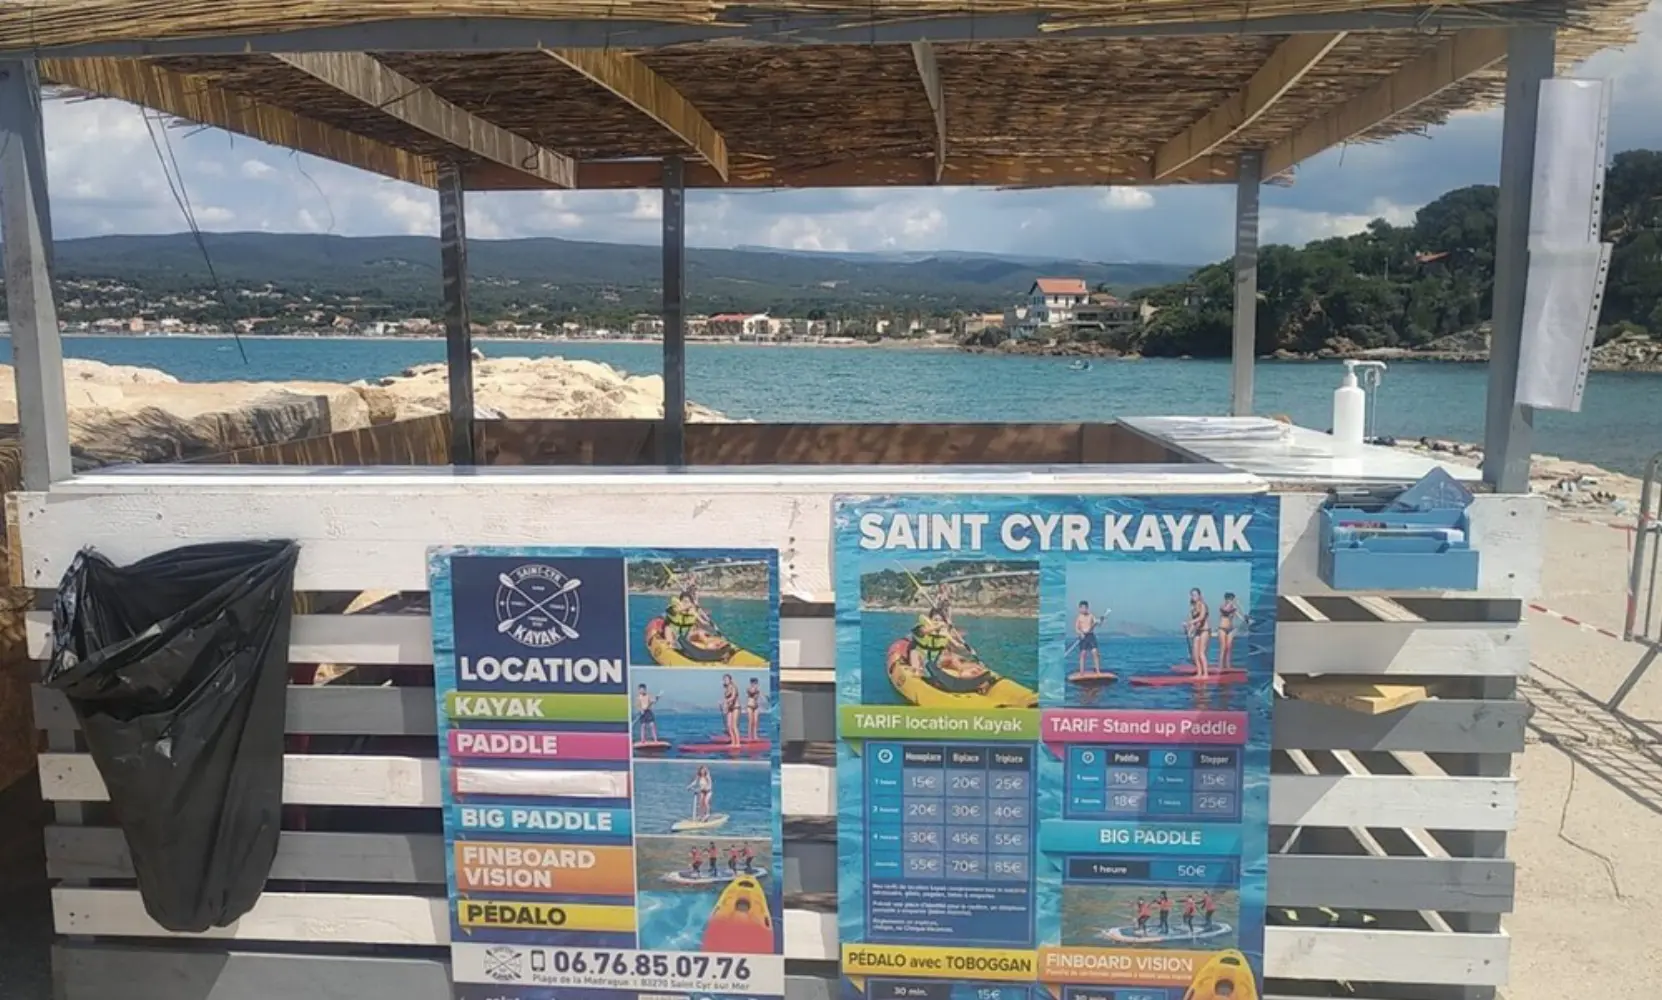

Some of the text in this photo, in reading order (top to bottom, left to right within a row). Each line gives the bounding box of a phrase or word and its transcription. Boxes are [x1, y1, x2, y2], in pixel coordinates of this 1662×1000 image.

[859, 513, 1253, 552] SAINT CYR KAYAK
[513, 624, 561, 645] KAYAK
[460, 656, 623, 684] LOCATION
[454, 695, 545, 717] KAYAK
[855, 714, 1022, 734] TARIF location Kayak
[1050, 717, 1237, 737] TARIF Stand up Paddle
[456, 733, 557, 755] PADDLE
[911, 775, 936, 789] 15€
[952, 776, 980, 790] 20€
[995, 777, 1023, 791] 25€
[1114, 773, 1140, 785] 10€
[1202, 773, 1227, 786] 15€
[1114, 795, 1139, 808] 18€
[1200, 796, 1228, 809] 25€
[910, 803, 937, 816] 20€
[952, 805, 980, 818] 30€
[994, 805, 1022, 818] 40€
[460, 807, 612, 832] BIG PADDLE
[910, 831, 937, 844] 30€
[951, 832, 980, 845] 45€
[994, 833, 1022, 846] 55€
[1100, 828, 1202, 846] BIG PADDLE
[462, 846, 596, 869] FINBOARD
[910, 859, 937, 871] 55€
[951, 860, 979, 873] 70€
[1099, 864, 1128, 875] heure
[1178, 864, 1206, 877] 50€
[463, 867, 552, 889] VISION
[467, 901, 567, 926] PÉDALO
[554, 950, 751, 980] 06.76.85.07.76
[848, 948, 1032, 973] PÉDALO avec TOBOGGAN
[1046, 952, 1193, 972] FINBOARD VISION
[532, 973, 558, 985] Plage
[560, 975, 570, 984] de
[572, 974, 581, 984] la
[584, 975, 629, 988] Madrague
[671, 979, 693, 989] Saint
[696, 980, 711, 991] Cyr
[714, 982, 729, 991] sur
[731, 982, 750, 991] Mer
[893, 985, 928, 997] 30 min.
